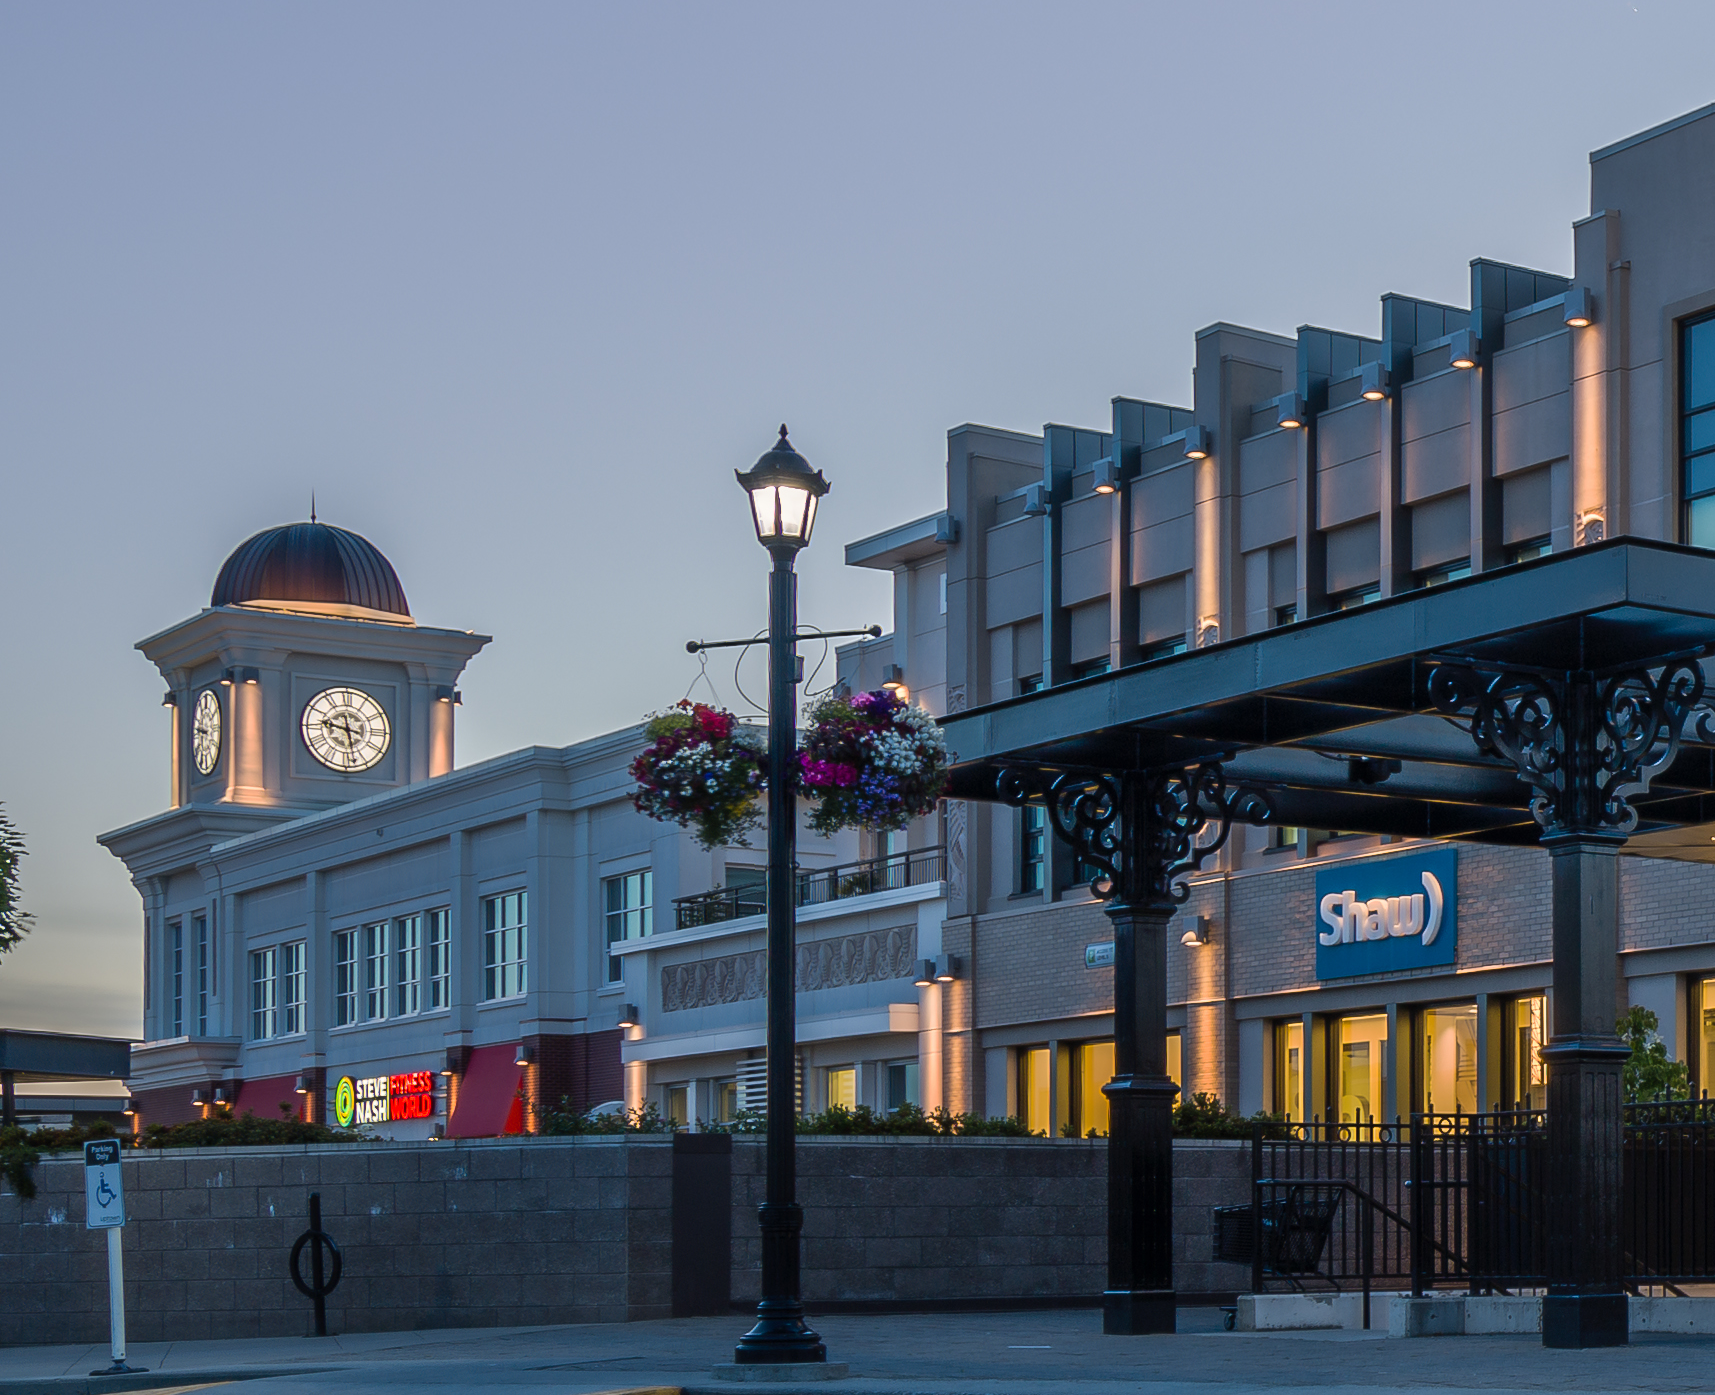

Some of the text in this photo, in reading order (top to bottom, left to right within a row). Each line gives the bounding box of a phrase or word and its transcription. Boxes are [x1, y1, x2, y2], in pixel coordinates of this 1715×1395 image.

[356, 1077, 387, 1099] STEVE
[390, 1071, 432, 1095] FITNESS
[355, 1100, 387, 1124] NASH
[390, 1094, 432, 1121] WORLD
[91, 1145, 114, 1154] Parking
[95, 1153, 110, 1161] Only
